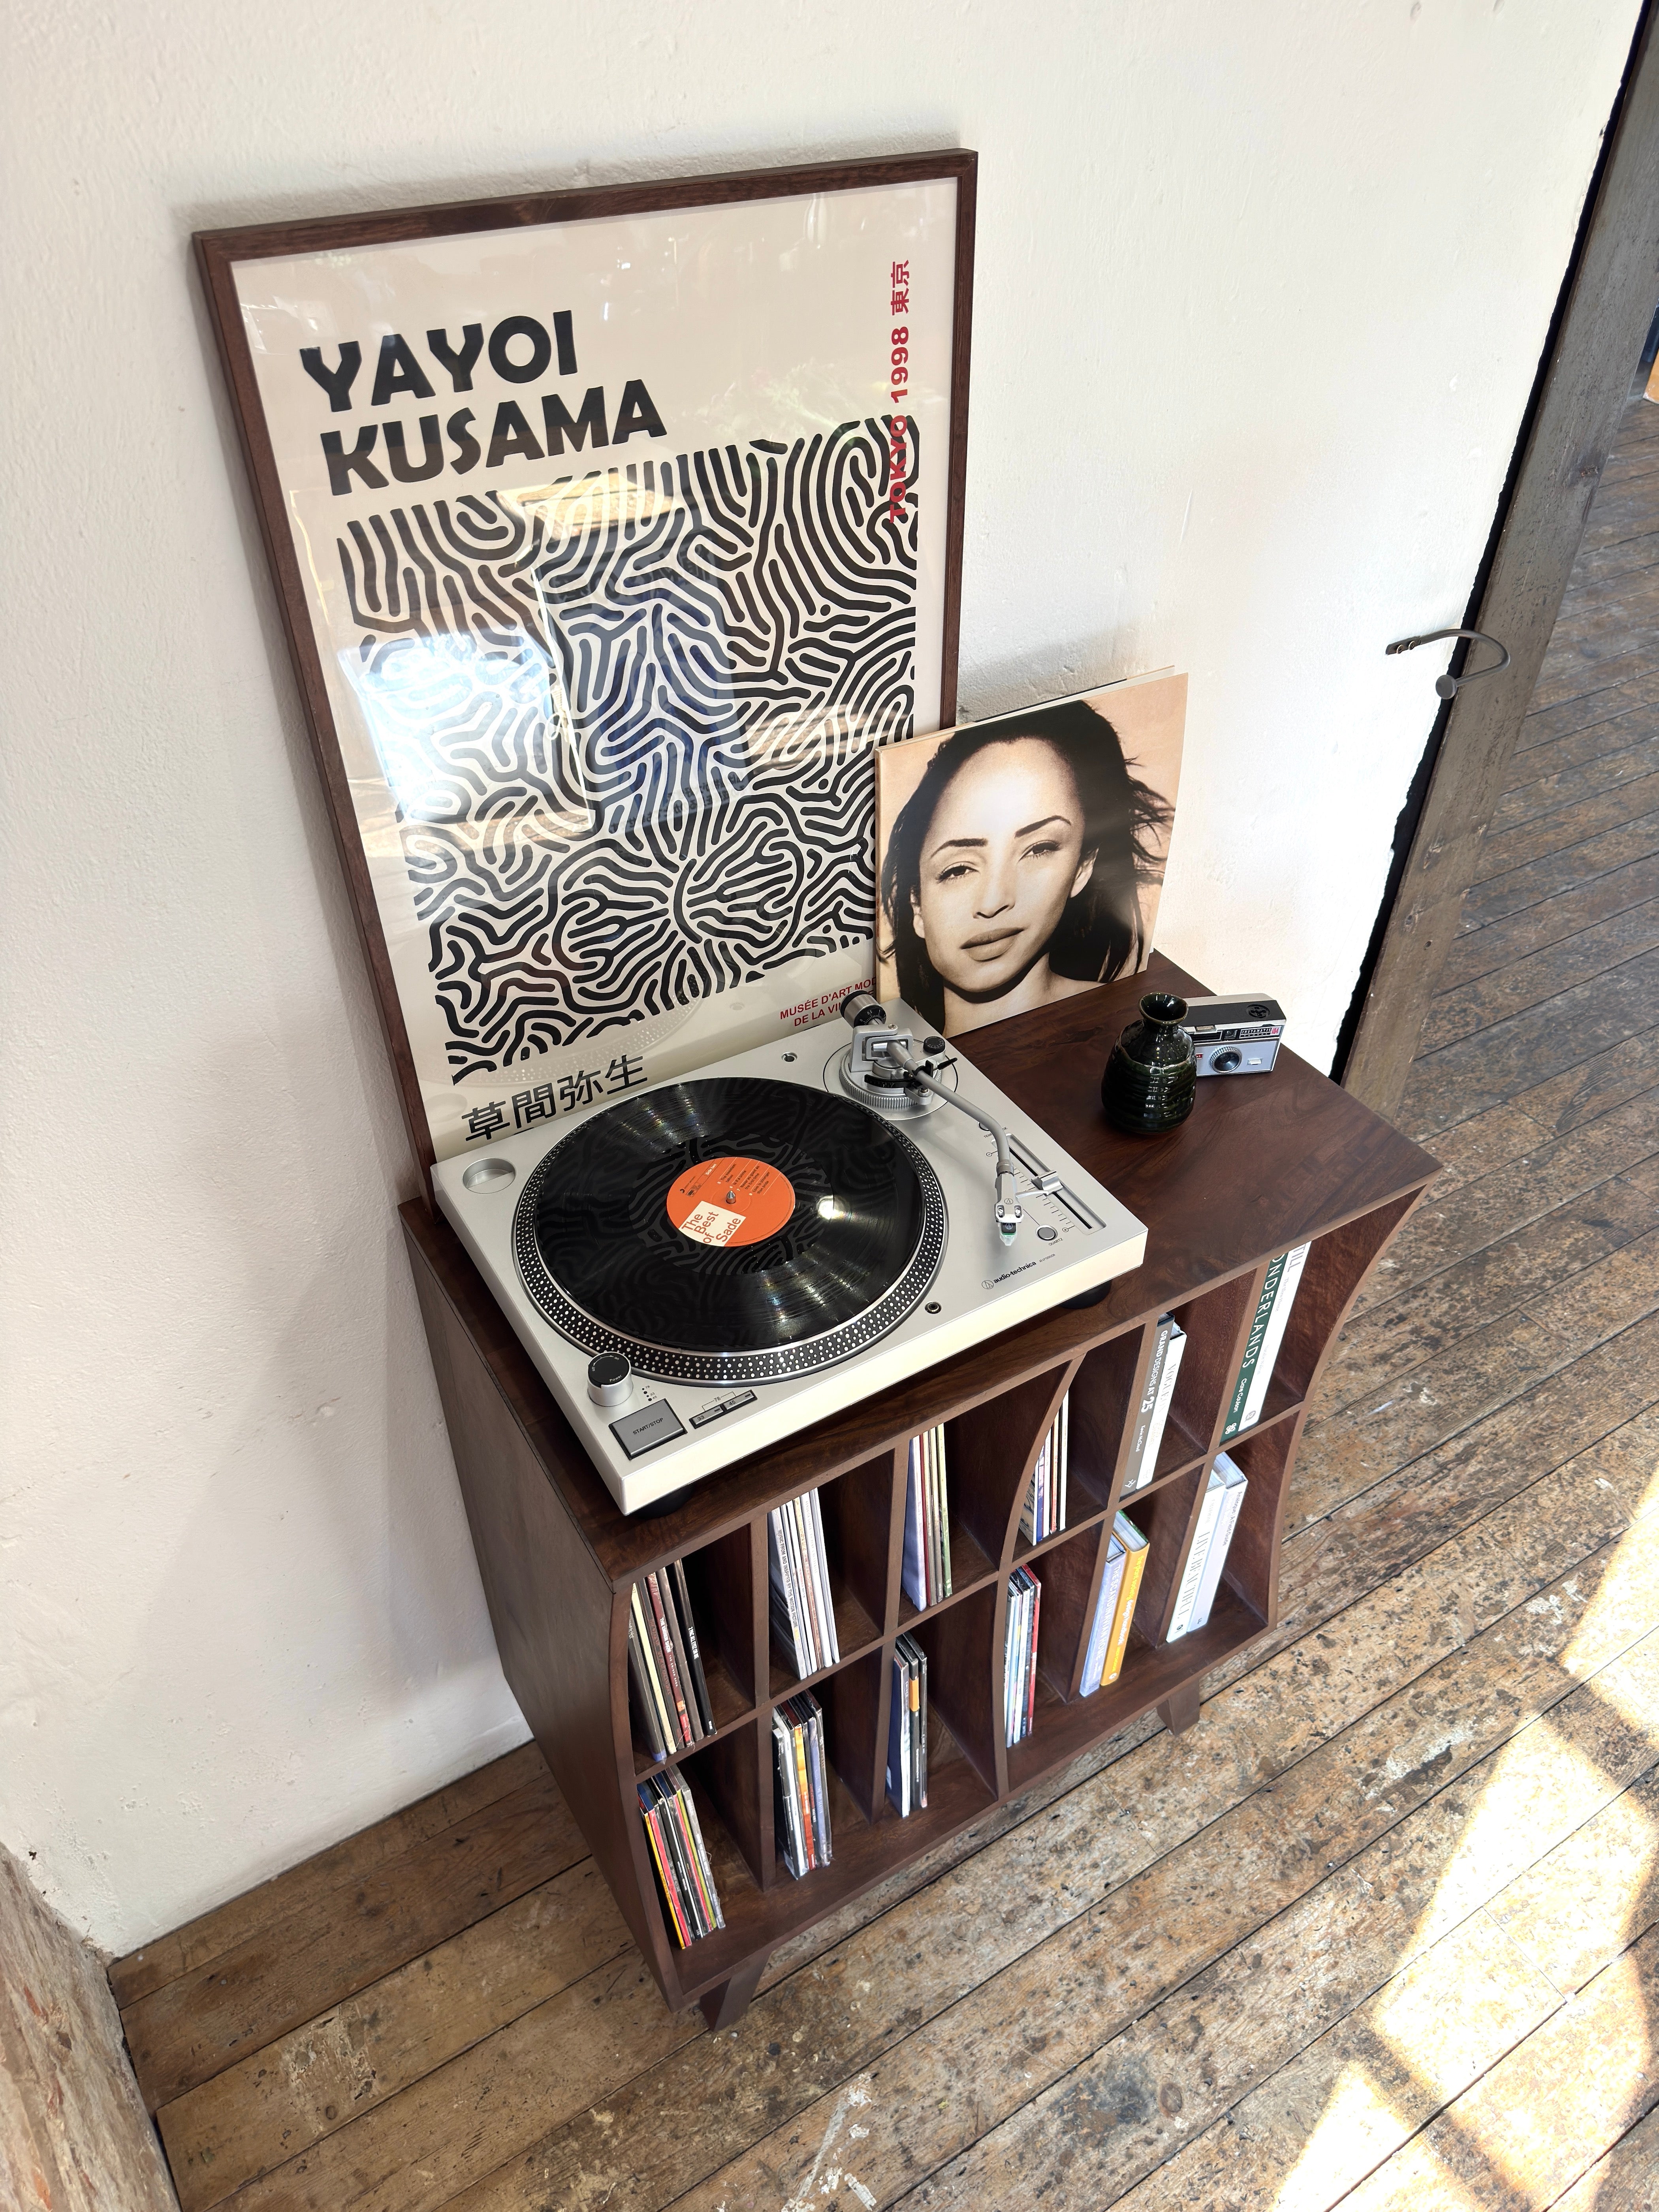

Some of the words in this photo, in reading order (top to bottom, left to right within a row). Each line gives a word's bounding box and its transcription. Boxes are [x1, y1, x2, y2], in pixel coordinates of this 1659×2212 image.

[890, 260, 909, 315] 東京
[299, 310, 578, 412] YAYOI
[891, 326, 909, 403] 1998
[320, 379, 667, 496] KUSAMA
[890, 415, 907, 523] TOKYO
[780, 999, 818, 1019] MUSÉE
[822, 986, 852, 1004] D'ART
[855, 977, 876, 990] MOD
[794, 1014, 809, 1027] DE
[812, 1009, 825, 1020] LA
[461, 1055, 648, 1141] 草間弥生
[681, 1214, 703, 1230] The
[693, 1212, 719, 1234] Best
[716, 1218, 741, 1242] Sade
[703, 1232, 715, 1243] of
[1048, 1238, 1063, 1246] QUARTZ
[1287, 1243, 1307, 1272] TILL
[993, 1261, 1037, 1283] audio-technica
[1242, 1253, 1285, 1368] ONDERLANDS
[1156, 1330, 1168, 1357] GRAND
[1149, 1357, 1162, 1386] DESIGNS
[1161, 1363, 1176, 1400] VOGUE
[1141, 1396, 1155, 1413] 25
[1147, 1386, 1155, 1396] AT
[632, 1417, 663, 1435] START/STOP
[1112, 1564, 1121, 1580] THE
[1100, 1579, 1119, 1638] SCANDINAVIAN
[1096, 1638, 1106, 1661] HOME
